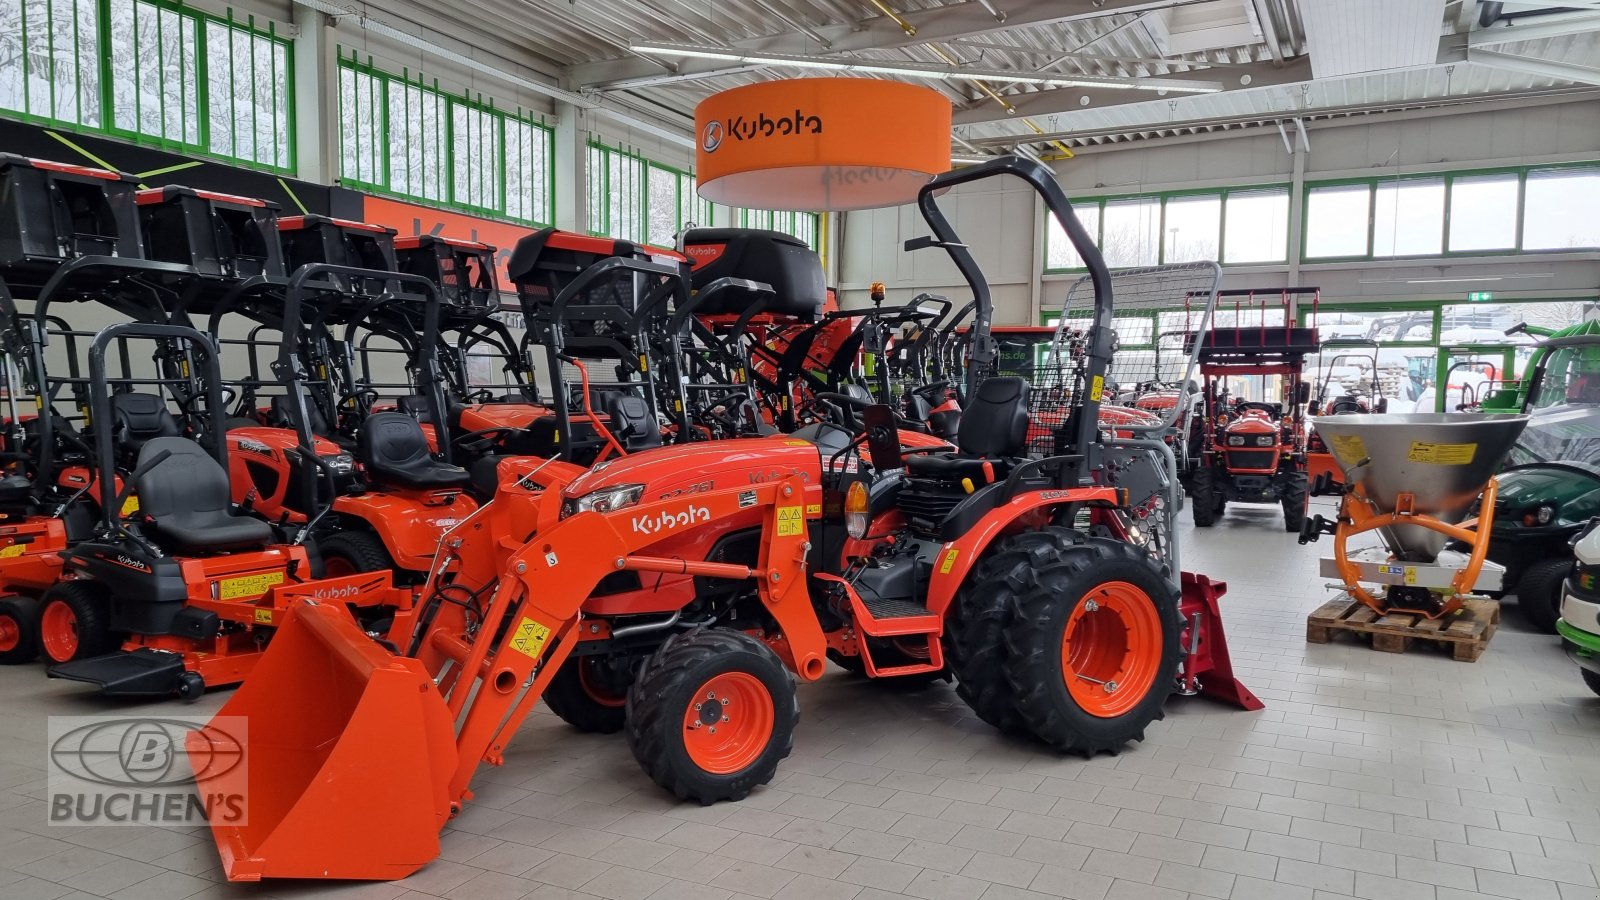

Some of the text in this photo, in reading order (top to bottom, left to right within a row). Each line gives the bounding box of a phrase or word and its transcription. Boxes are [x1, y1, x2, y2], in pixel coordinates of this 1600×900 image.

[728, 109, 822, 141] Kubota
[687, 246, 716, 255] Kubota
[632, 504, 711, 535] Kubota
[117, 554, 145, 569] Kubota
[314, 584, 359, 599] Kubota
